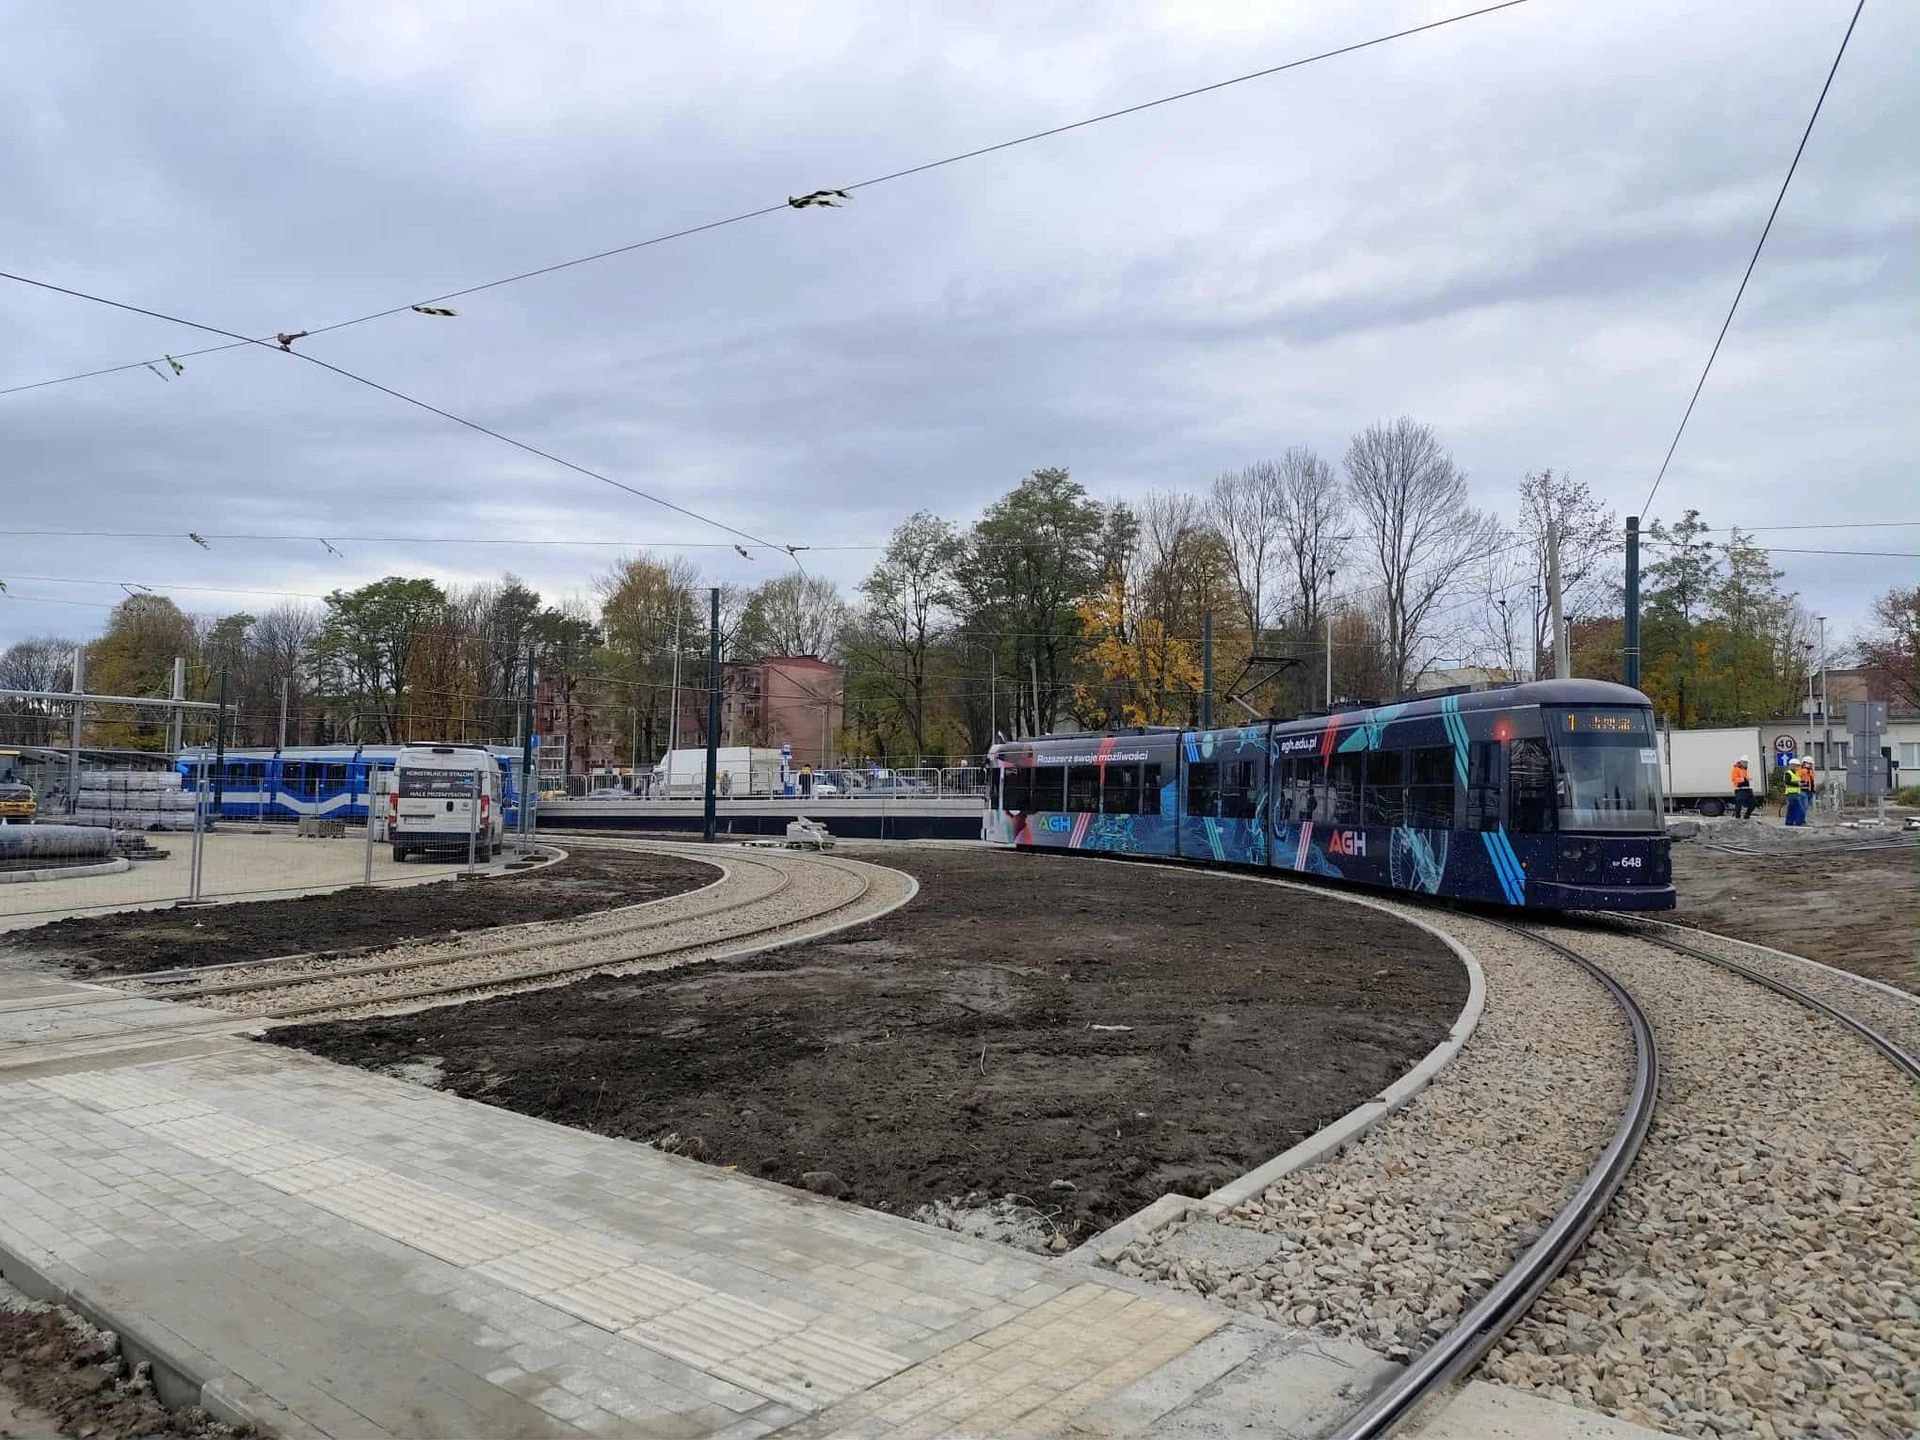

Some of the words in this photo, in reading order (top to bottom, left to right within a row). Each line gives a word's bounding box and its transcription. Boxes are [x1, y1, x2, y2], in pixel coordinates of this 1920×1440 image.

[1567, 714, 1576, 731] 1
[1280, 734, 1318, 754] agh.edu.pl
[1777, 739, 1793, 749] 40
[1037, 754, 1073, 764] Rozszerz
[1074, 753, 1098, 764] swoje
[1098, 749, 1149, 761] możliwości
[1039, 815, 1071, 832] AGH
[1328, 829, 1367, 857] AGH
[1621, 857, 1642, 867] 648
